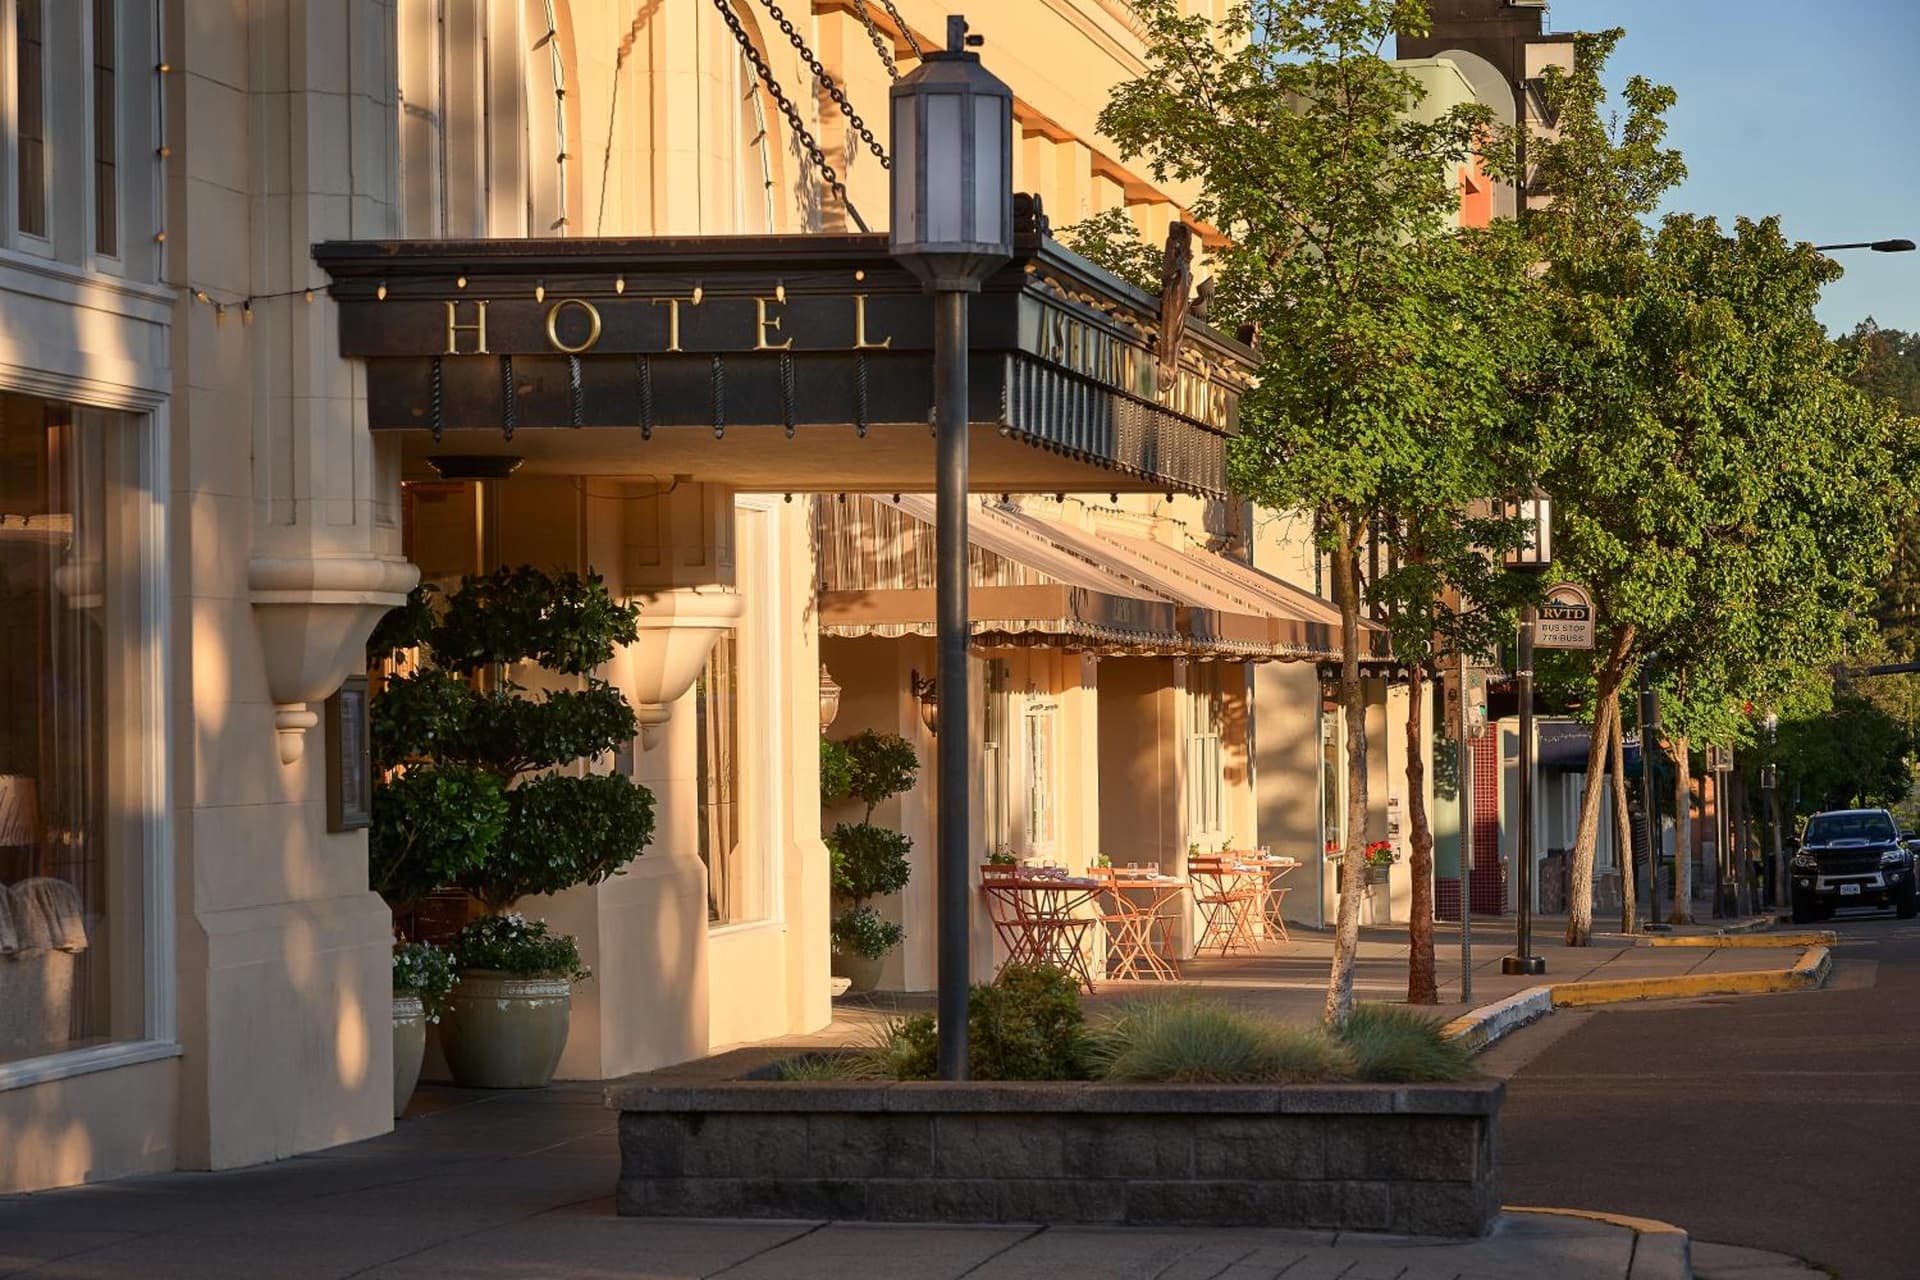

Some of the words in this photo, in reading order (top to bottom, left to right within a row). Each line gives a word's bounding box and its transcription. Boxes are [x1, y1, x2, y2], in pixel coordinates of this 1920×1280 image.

[444, 295, 892, 354] HOTEL
[1544, 608, 1585, 619] RVTD
[1542, 624, 1560, 632] BUS
[1562, 624, 1585, 632] STOP
